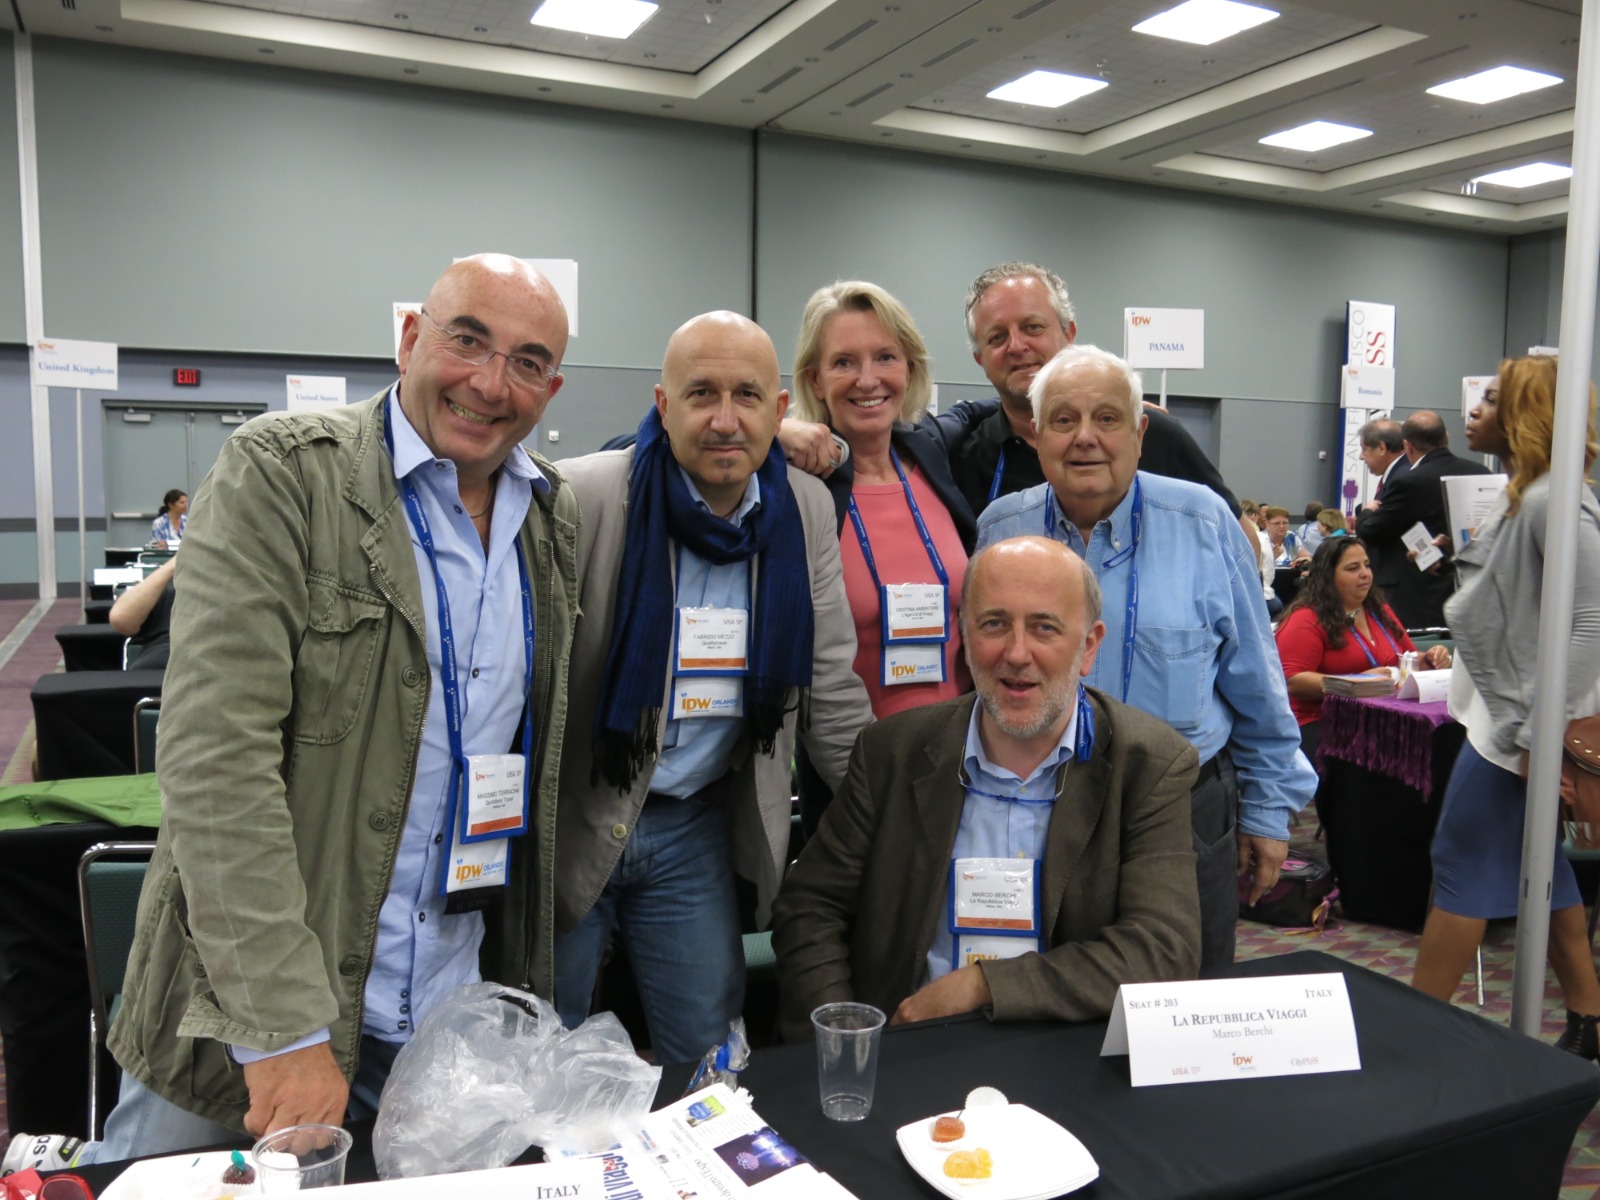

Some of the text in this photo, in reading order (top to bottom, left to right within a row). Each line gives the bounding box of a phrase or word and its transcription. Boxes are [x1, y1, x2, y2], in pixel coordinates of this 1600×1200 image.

[1131, 312, 1152, 327] ipw
[1149, 343, 1185, 352] PANAMA
[38, 362, 115, 376] United Kingdom
[176, 369, 198, 385] EXIT
[295, 394, 319, 402] United
[1358, 387, 1383, 396] Romania
[1344, 433, 1361, 474] SAN
[890, 661, 916, 680] ipw
[681, 692, 739, 713] ipw ORLANDO
[477, 791, 498, 800] MASSIMO
[455, 859, 505, 884] ipw ORLANDO
[1305, 989, 1333, 999] ITALY
[1154, 999, 1161, 1008] #
[1191, 1011, 1265, 1026] REPUBBLICA
[1266, 1008, 1308, 1020] VIAGGI
[1212, 1026, 1273, 1039] Marco Berchi
[1232, 1052, 1253, 1067] ipw
[536, 1184, 582, 1200] ITALY
